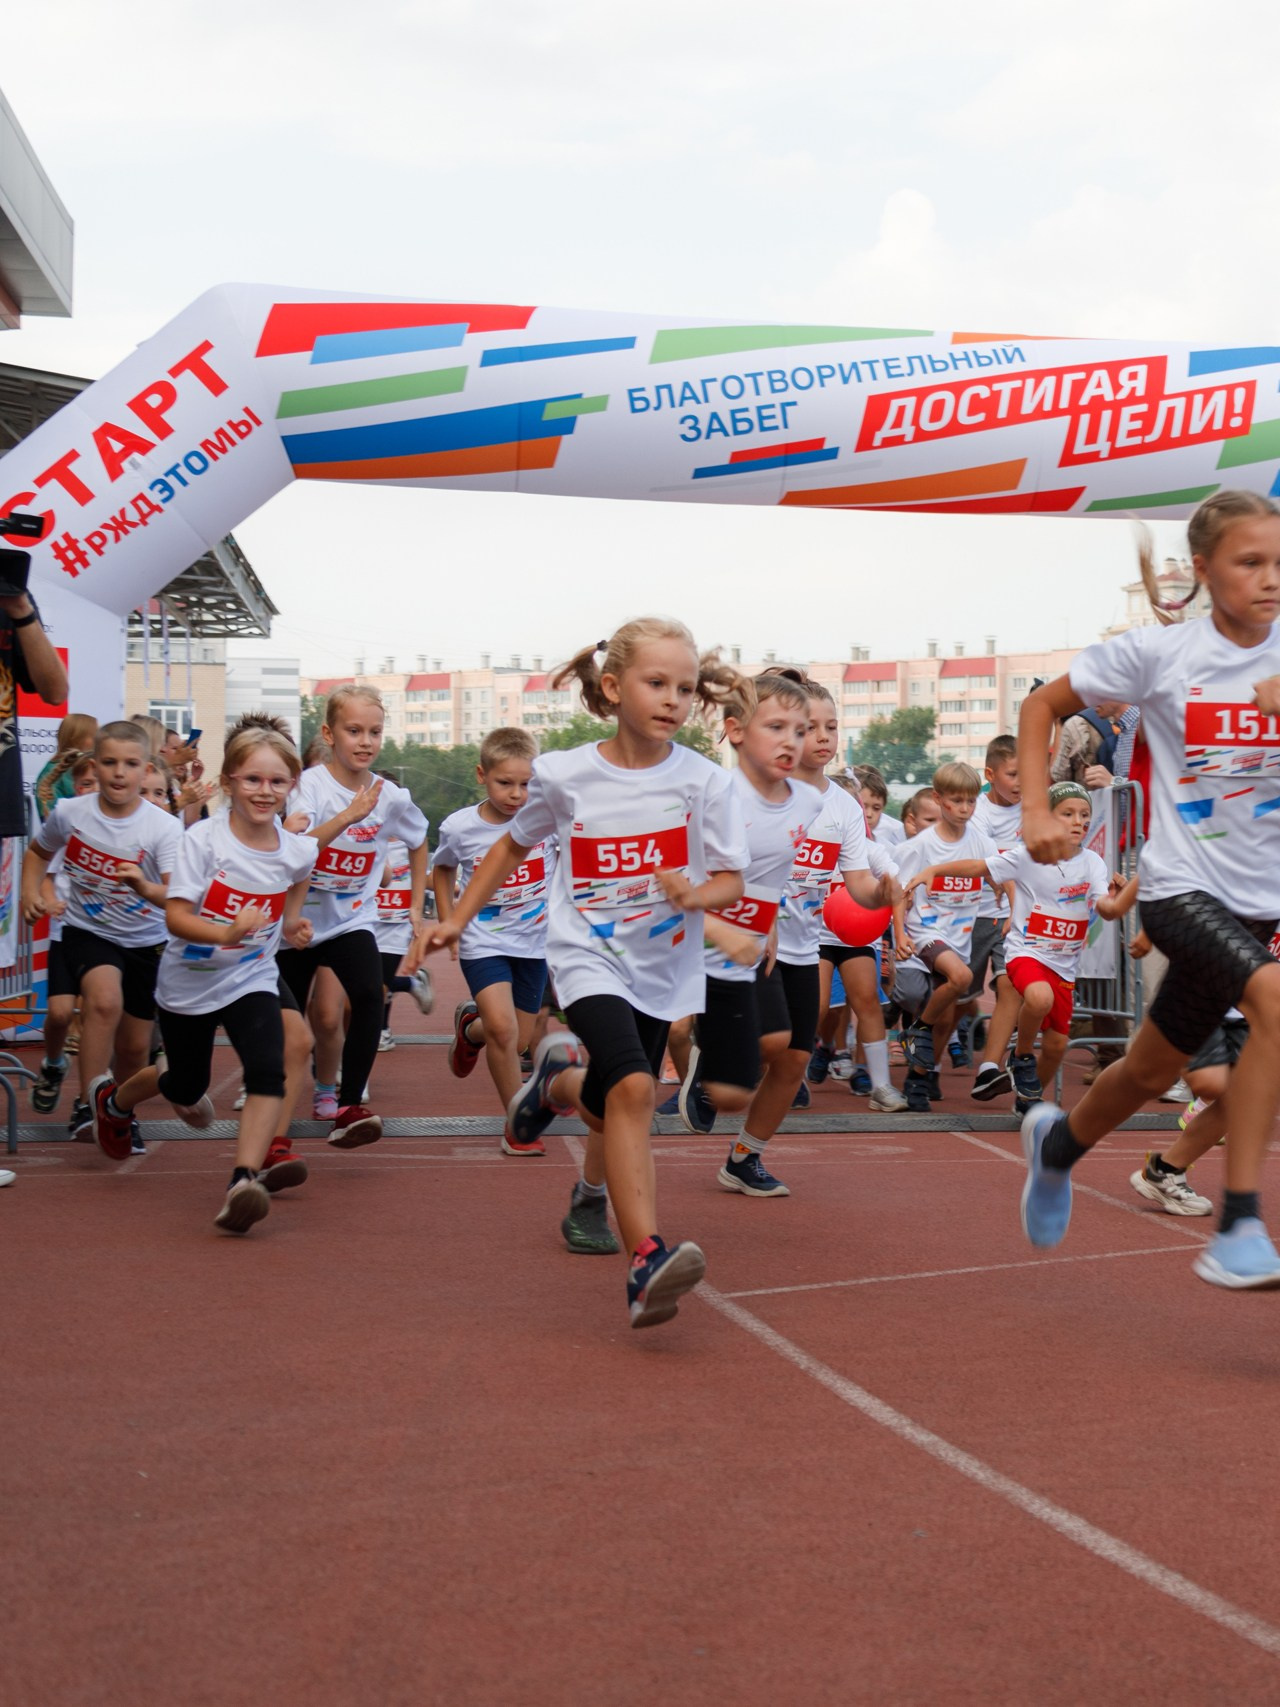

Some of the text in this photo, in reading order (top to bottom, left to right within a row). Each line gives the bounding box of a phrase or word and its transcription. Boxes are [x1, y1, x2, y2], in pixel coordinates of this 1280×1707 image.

[626, 344, 1026, 413] БЛАГОТВОРИТЕЛЬНЫЙ
[872, 364, 1149, 447] ДОСТИГАЯ
[679, 401, 798, 443] ЗАБЕГ
[1072, 387, 1247, 459] ЦЕЛИ!
[0, 339, 229, 548] СТАРТ
[1214, 709, 1280, 740] 151
[77, 847, 117, 877] 556
[325, 853, 367, 874] 149
[597, 839, 663, 873] 554
[796, 843, 824, 865] 56
[943, 876, 973, 890] 559
[711, 900, 759, 925] 22
[1042, 919, 1078, 939] 130
